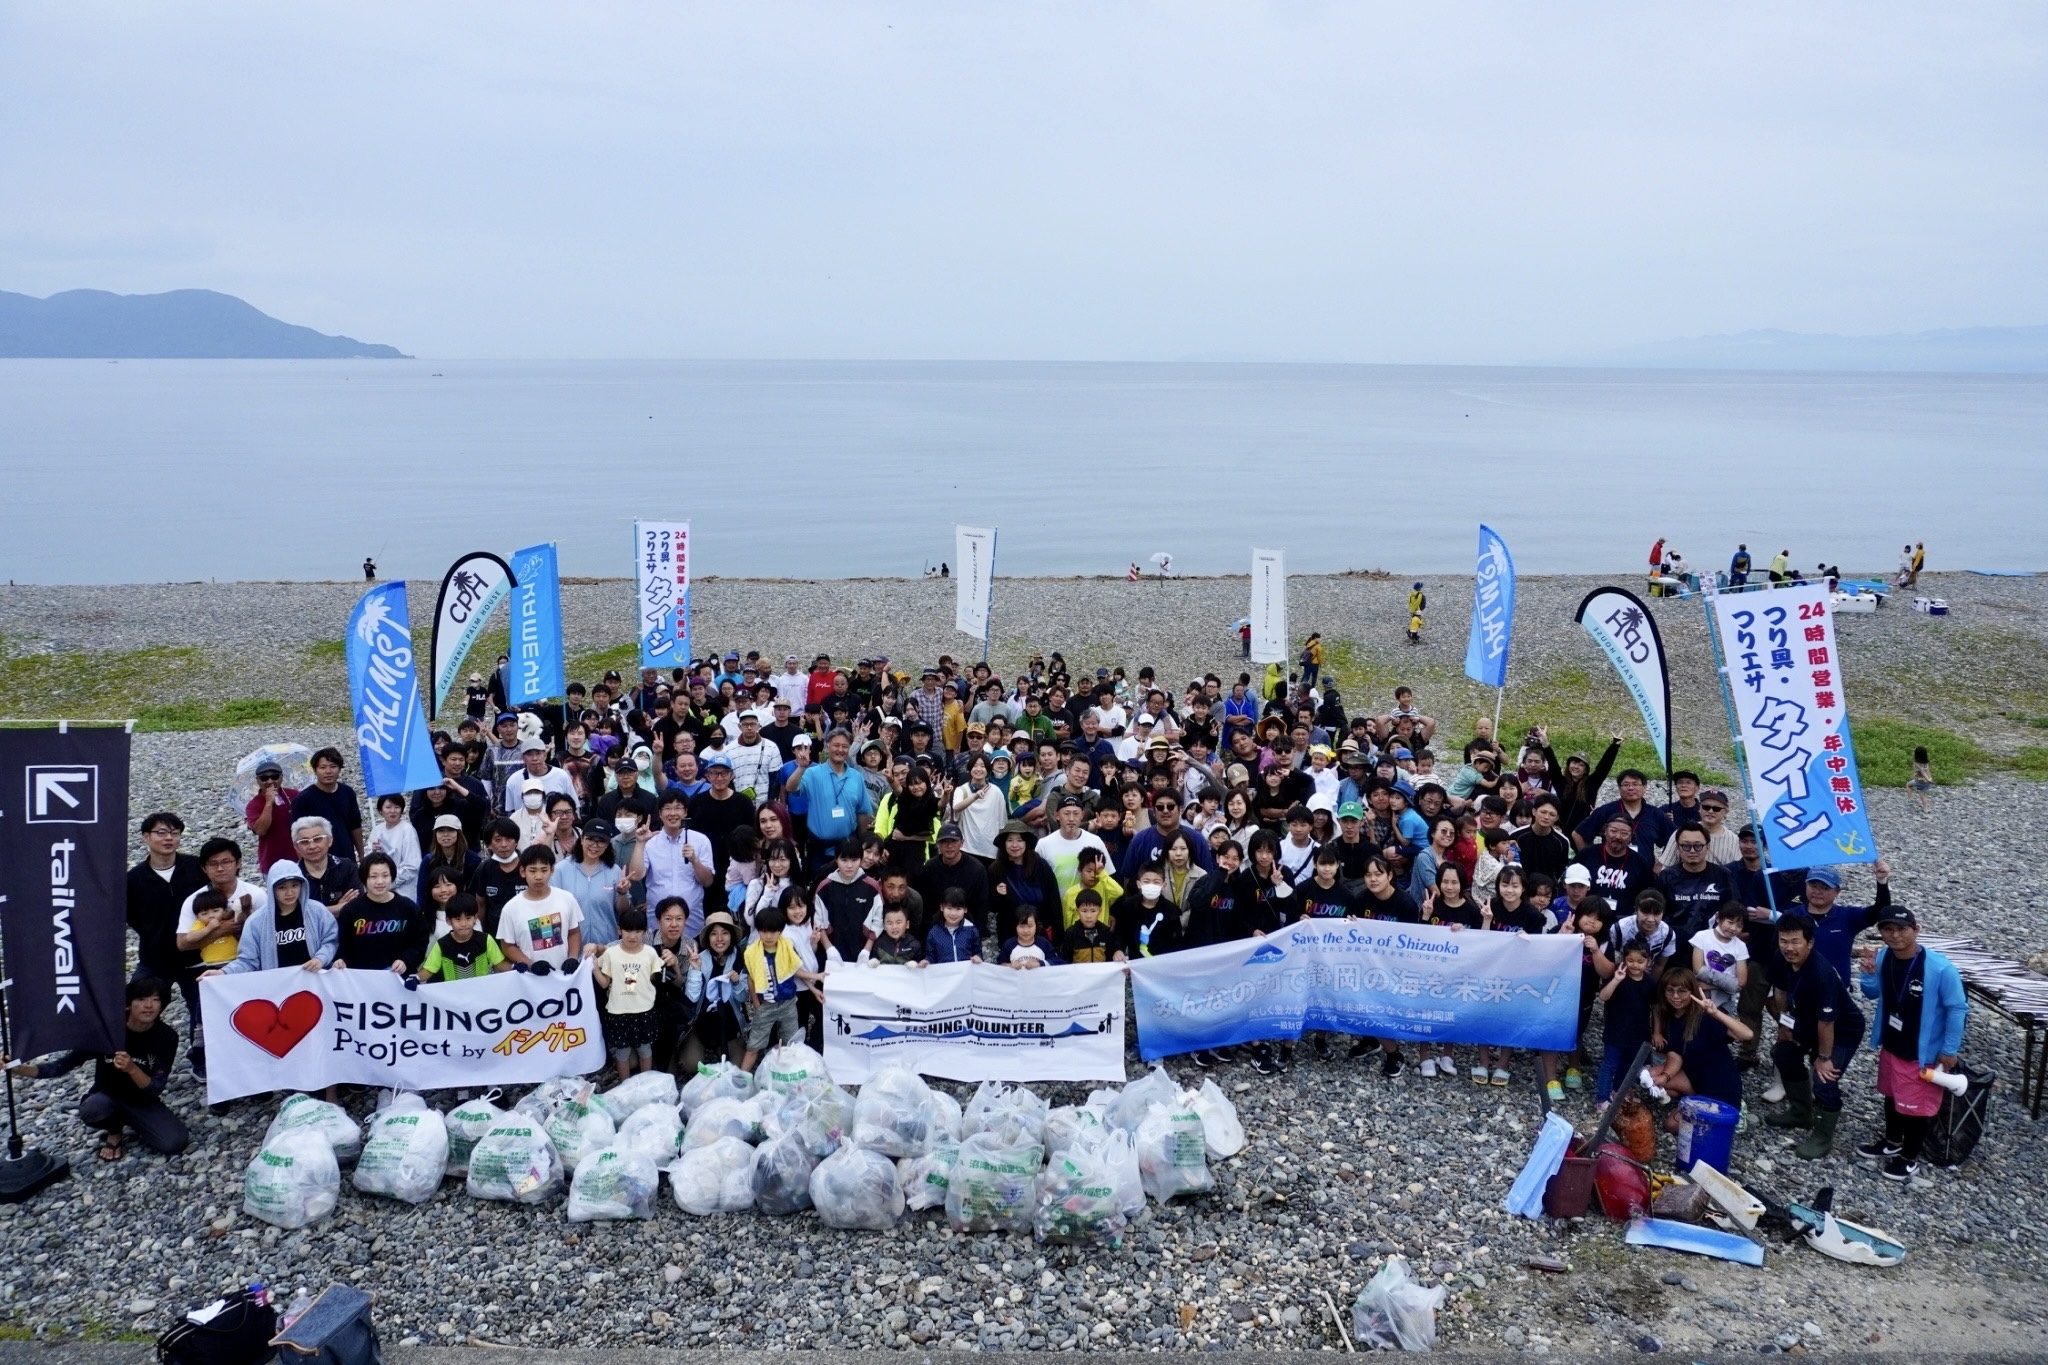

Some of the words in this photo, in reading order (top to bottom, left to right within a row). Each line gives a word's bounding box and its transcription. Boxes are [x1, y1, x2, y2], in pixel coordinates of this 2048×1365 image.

[646, 531, 657, 574] つりエサ
[449, 572, 490, 624] CPH
[440, 642, 467, 690] CALIFORNIA
[466, 617, 481, 640] PALM
[480, 590, 502, 615] HOUSE
[1731, 610, 1766, 694] つりエサ
[1798, 601, 1857, 815] 24時間営業・年中無休
[1752, 696, 1833, 850] タイシ
[51, 838, 80, 1015] tailwalk
[354, 918, 408, 936] BLOOM
[1291, 932, 1320, 947] Save
[1322, 932, 1343, 944] the
[1347, 929, 1373, 944] Sea
[1377, 936, 1392, 947] of
[1396, 934, 1460, 955] Shizuoka
[333, 988, 583, 1033] FISHINGOOD
[905, 1020, 963, 1035] FISHING
[965, 1018, 1045, 1034] VOLUNTEER
[333, 1028, 451, 1066] Project
[462, 1045, 486, 1060] by
[492, 1022, 587, 1056] イシグロ
